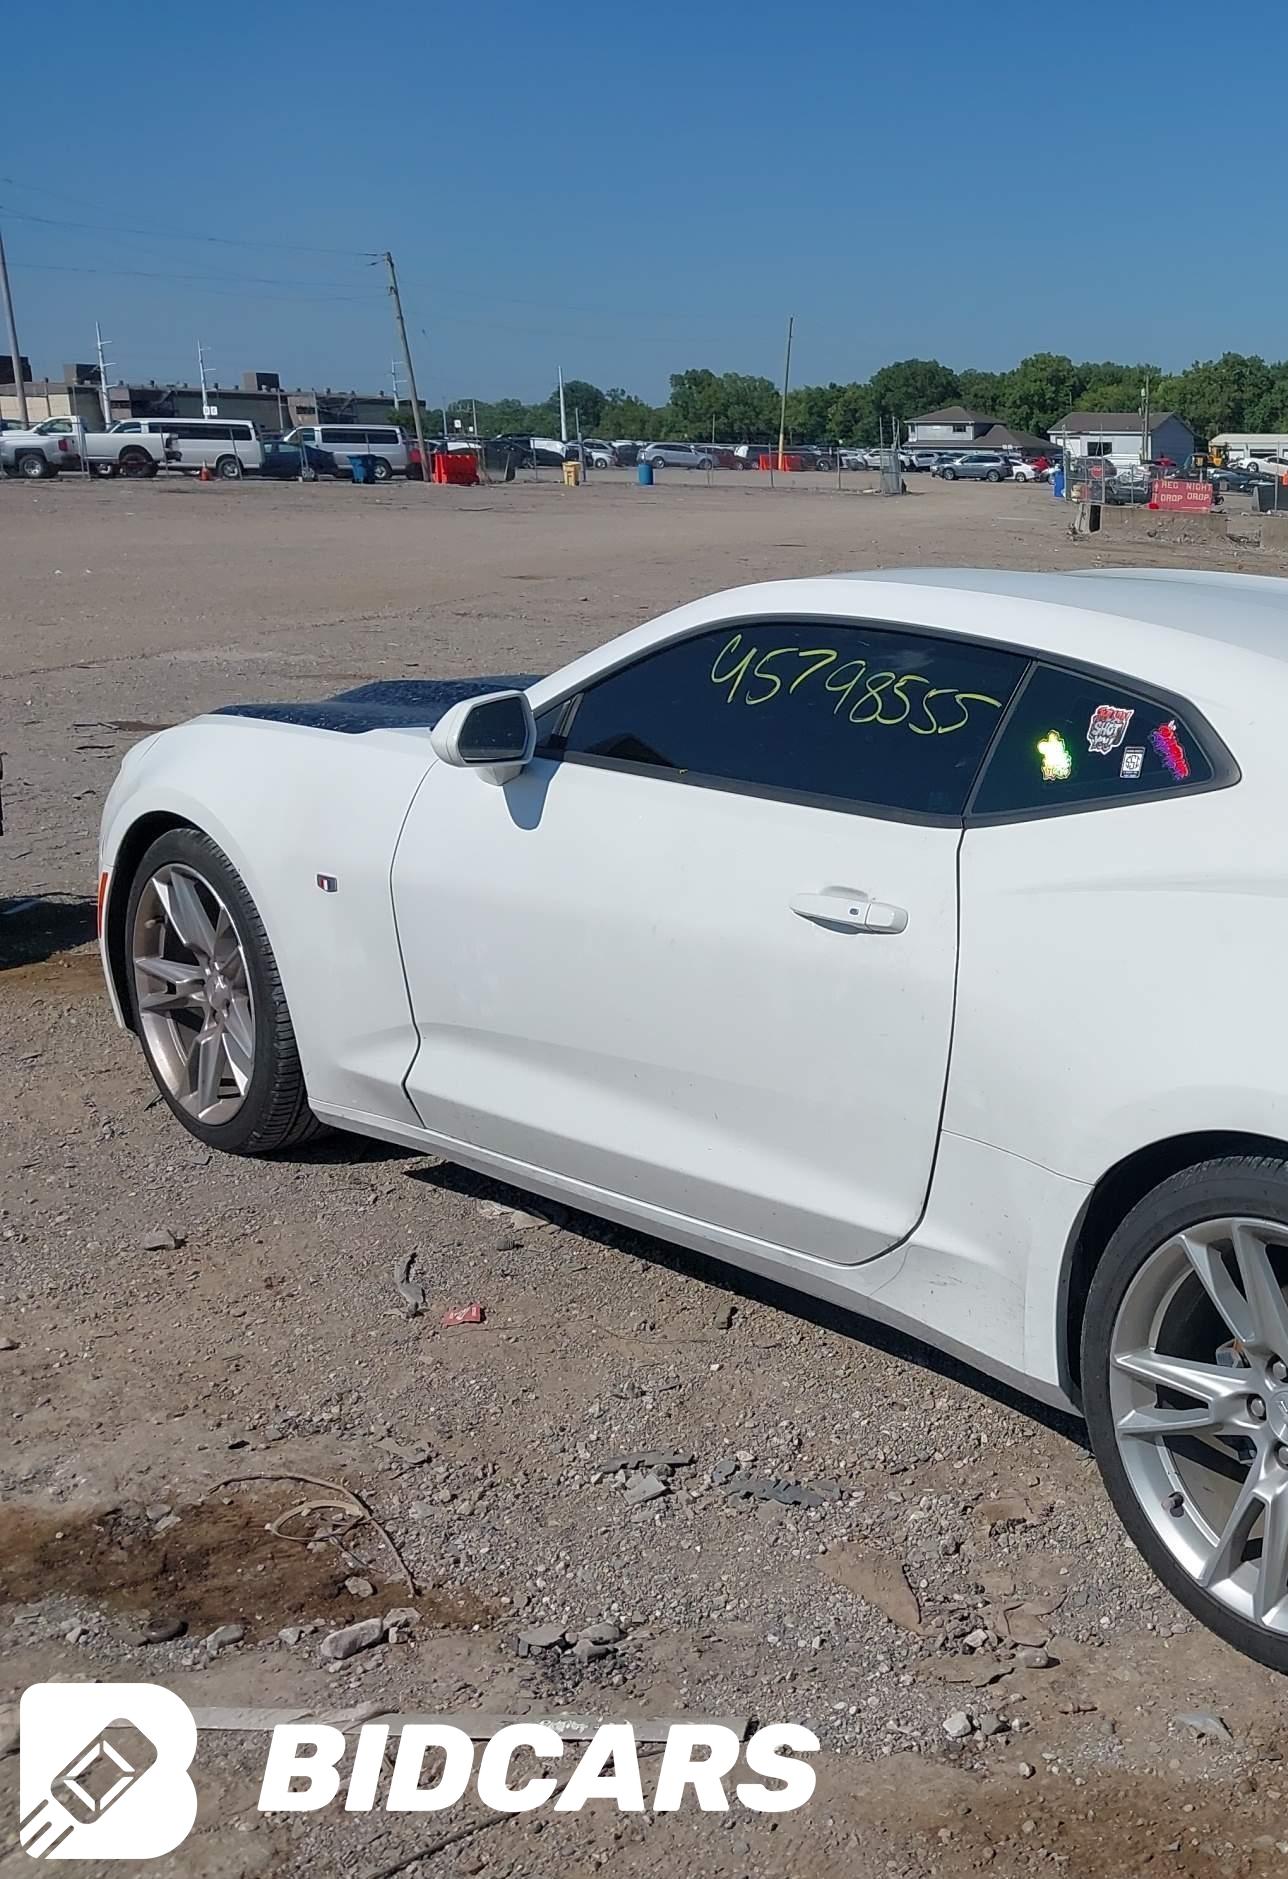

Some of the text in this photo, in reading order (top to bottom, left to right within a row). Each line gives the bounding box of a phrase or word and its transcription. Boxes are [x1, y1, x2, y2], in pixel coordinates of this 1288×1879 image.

[1186, 482, 1213, 492] NIGHT
[1160, 494, 1183, 502] DROP
[711, 633, 1003, 735] 45798555
[1091, 721, 1123, 737] SHOT
